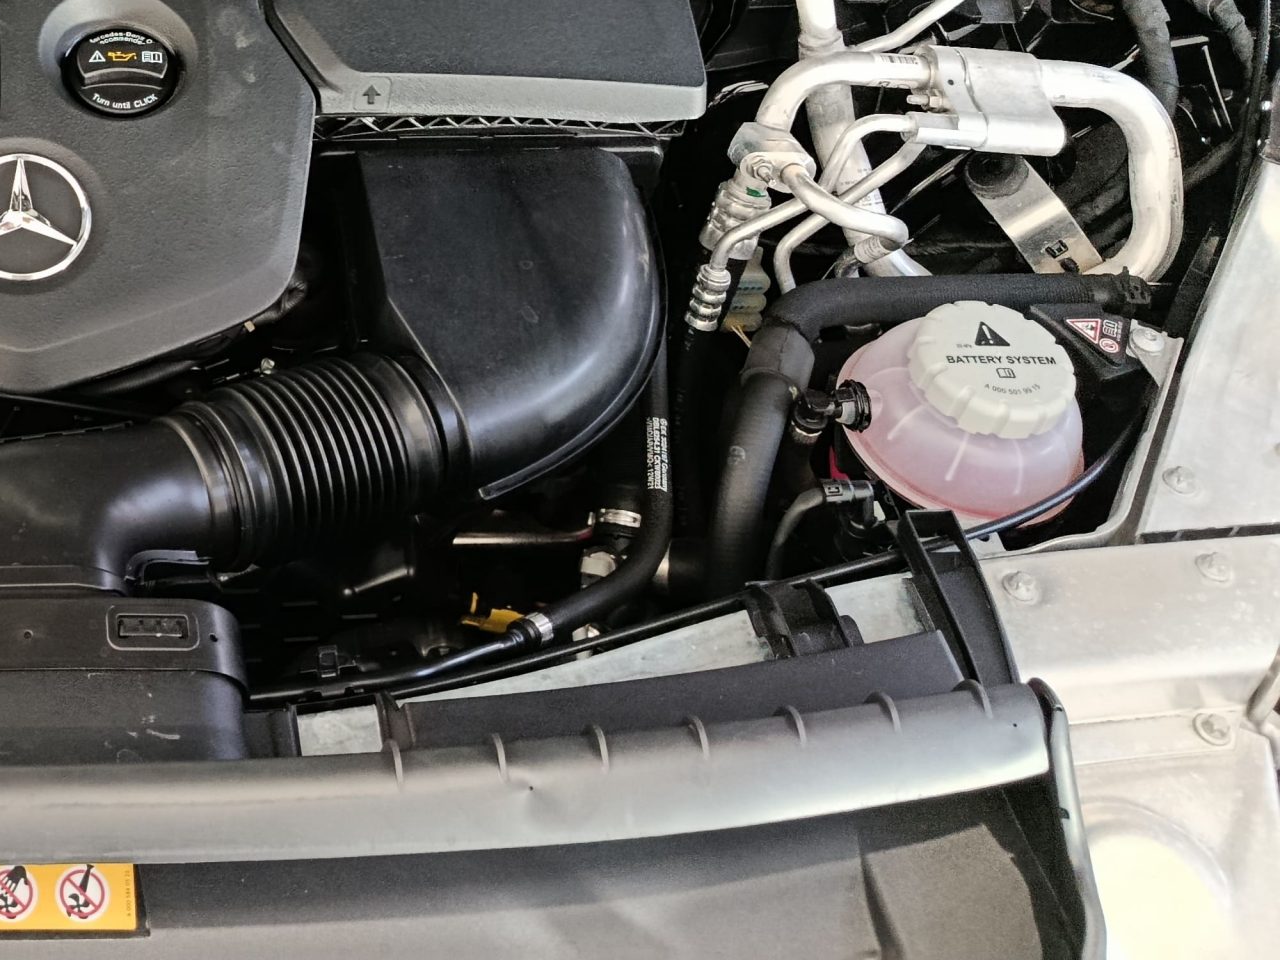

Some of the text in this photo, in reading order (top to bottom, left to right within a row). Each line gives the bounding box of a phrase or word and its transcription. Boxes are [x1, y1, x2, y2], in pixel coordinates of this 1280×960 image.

[93, 93, 158, 109] Turn until CLICK
[945, 355, 1057, 365] BATTERY SYSTEM
